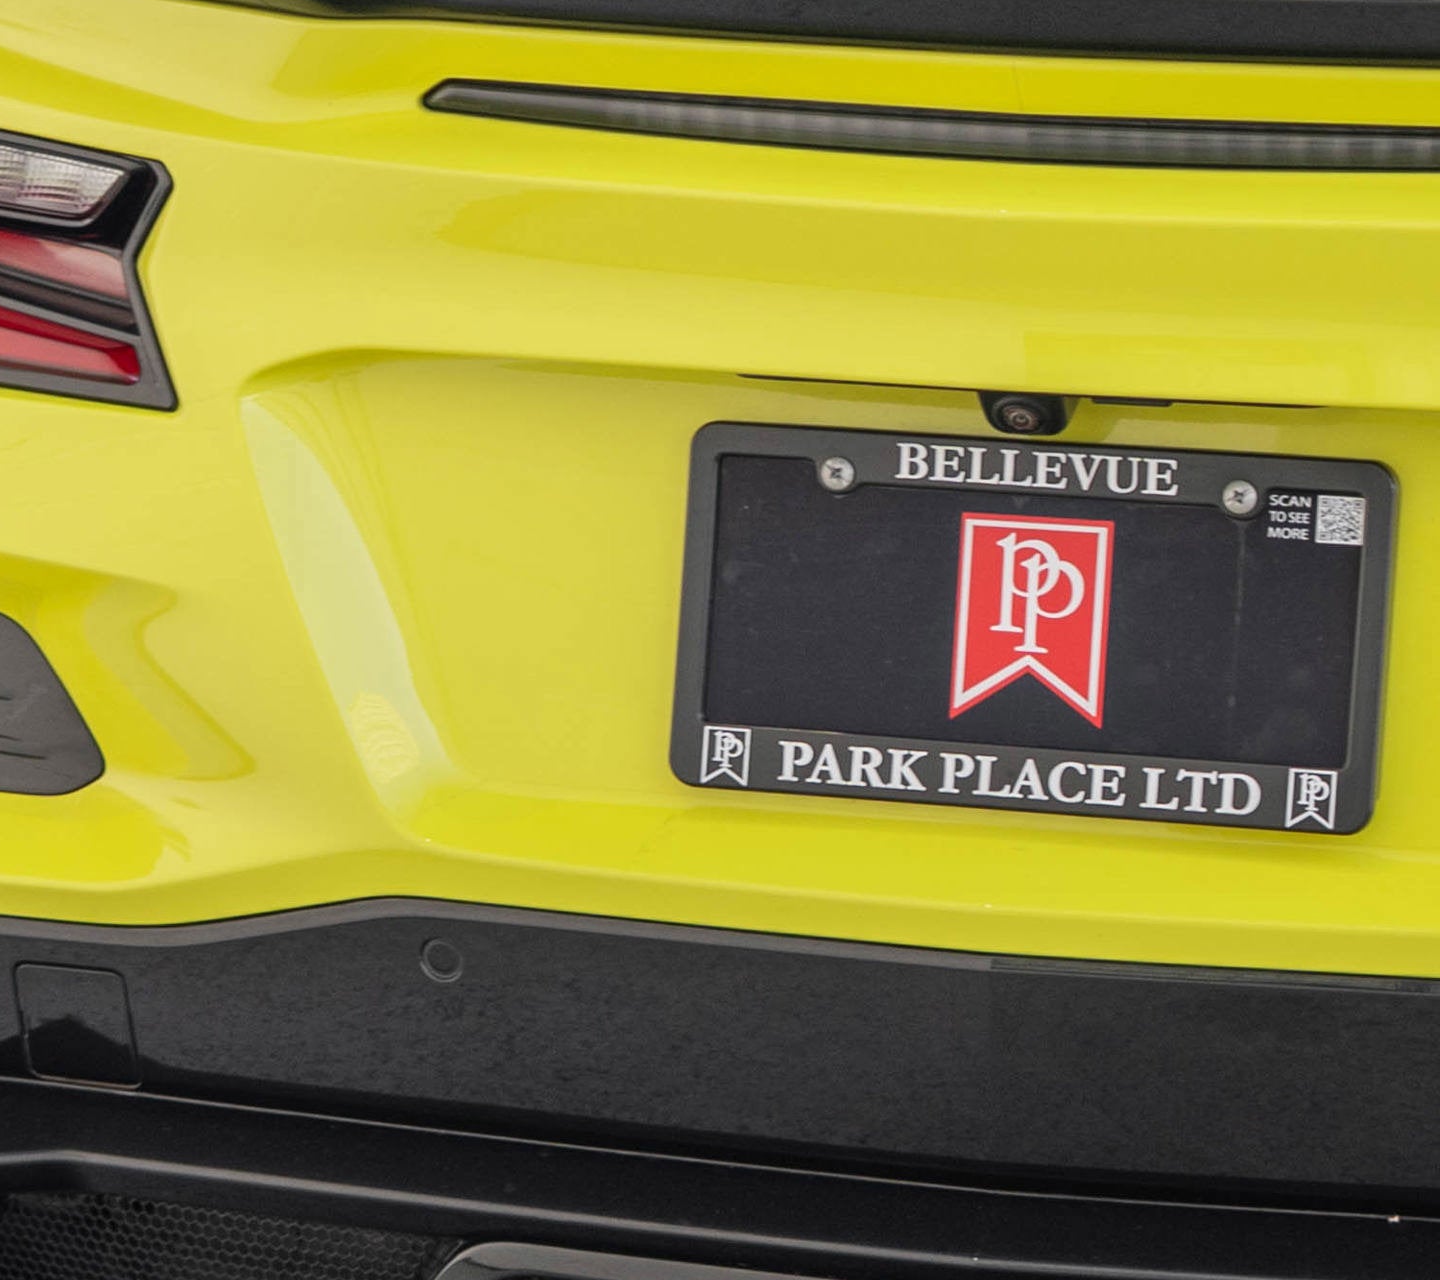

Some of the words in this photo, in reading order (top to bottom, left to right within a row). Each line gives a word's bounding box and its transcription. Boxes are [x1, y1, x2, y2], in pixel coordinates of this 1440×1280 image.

[894, 442, 1179, 497] BELLEVUE
[1268, 494, 1312, 508] SCAN
[1268, 510, 1287, 523] TO
[1287, 511, 1311, 525] SEE
[1266, 526, 1310, 541] MORE
[776, 740, 928, 792] PARK
[937, 752, 1127, 807] PLACE
[1138, 766, 1262, 817] LTD
